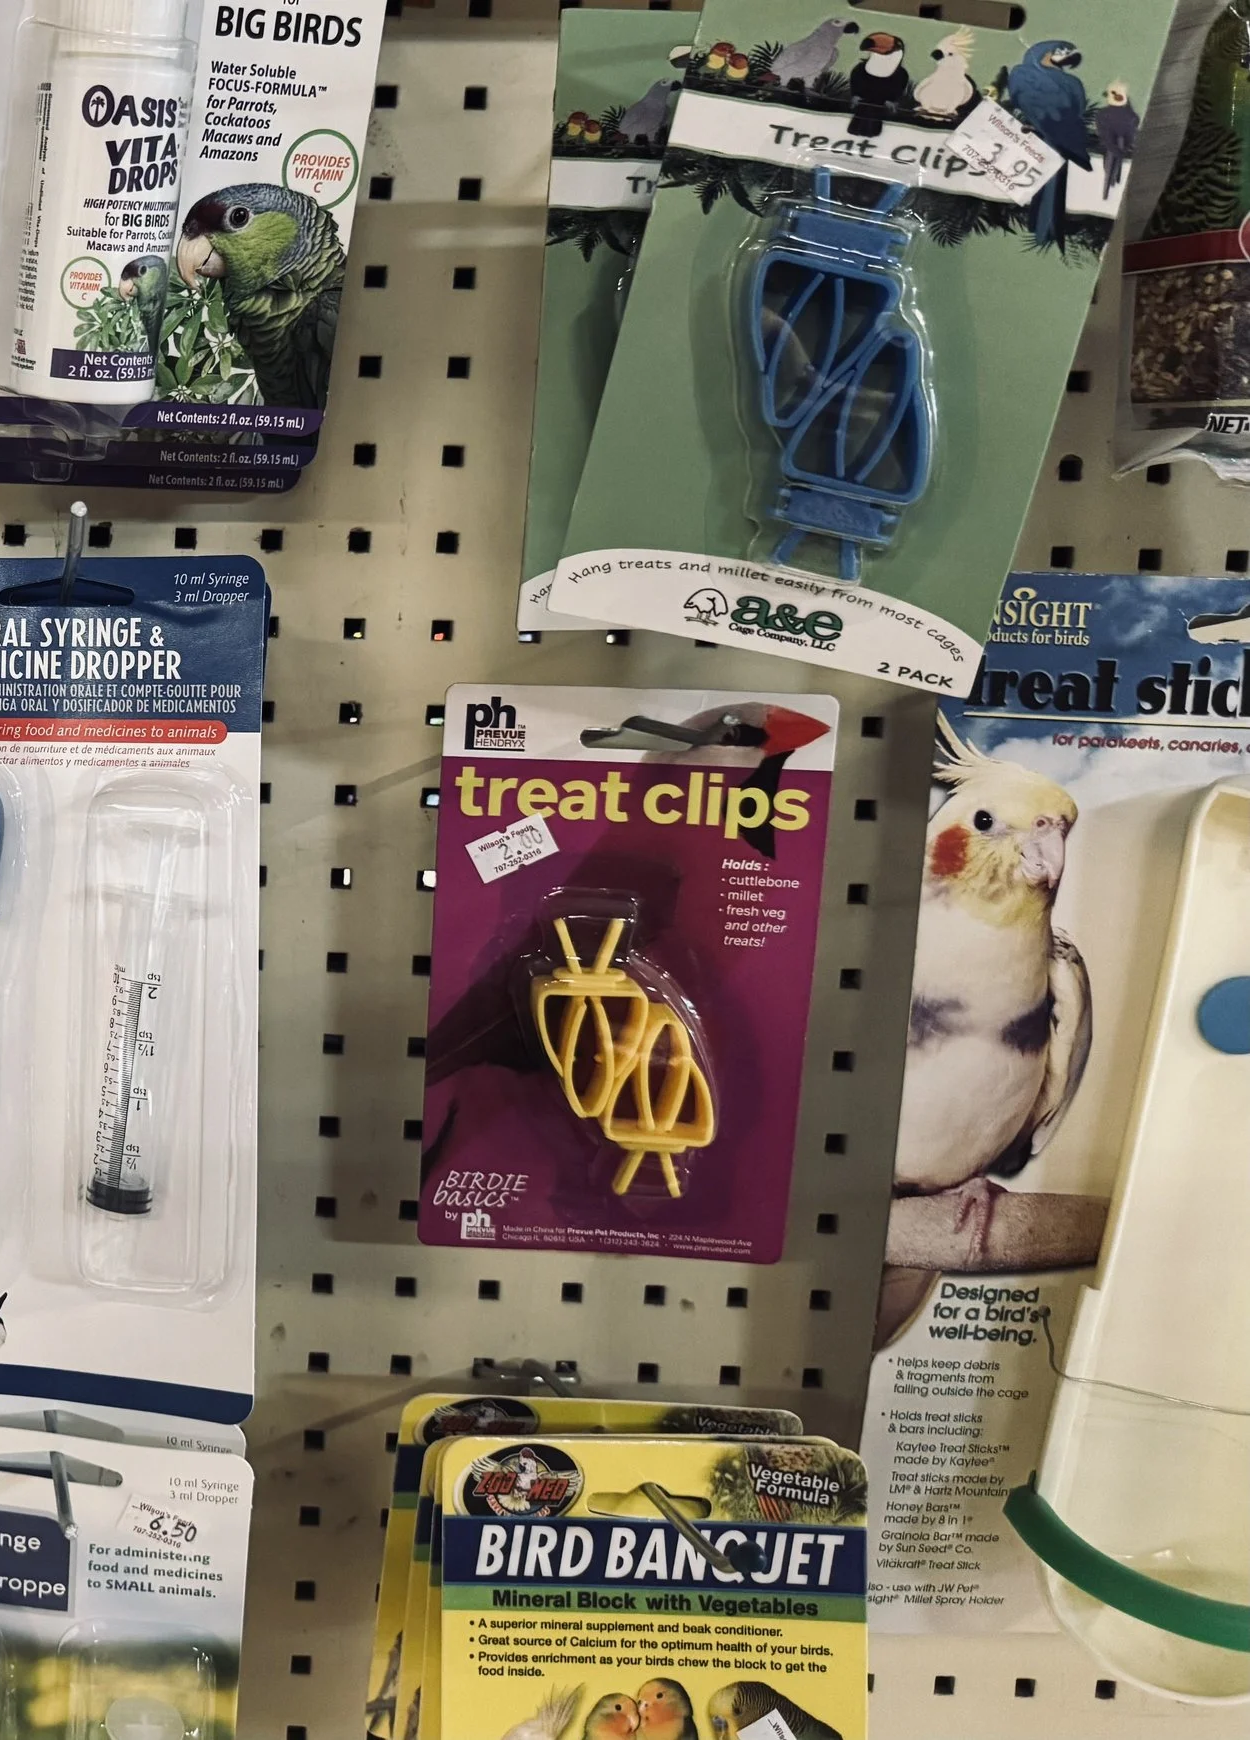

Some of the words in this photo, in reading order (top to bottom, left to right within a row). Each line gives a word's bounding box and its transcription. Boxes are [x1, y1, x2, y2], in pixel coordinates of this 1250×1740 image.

[216, 6, 265, 39] BIG
[273, 11, 362, 47] BIRDS
[205, 112, 270, 129] Cockatoos
[202, 129, 253, 144] Macaws
[256, 133, 282, 146] and
[770, 124, 877, 159] Treat
[199, 145, 258, 161] Amazons
[174, 574, 187, 585] 10
[190, 573, 205, 584] ml
[208, 573, 249, 587] Syringe
[174, 591, 181, 602] 3
[185, 590, 199, 602] ml
[203, 591, 249, 605] Dropper
[567, 559, 612, 583] Hang
[618, 557, 673, 572] treats
[679, 559, 711, 575] and
[717, 562, 769, 582] millet
[775, 575, 825, 596] easily
[831, 587, 873, 609] from
[878, 603, 922, 630] most
[926, 624, 965, 664] cages
[40, 618, 141, 647] SYRINGE
[150, 626, 164, 646] &
[728, 621, 758, 637] Cage
[71, 650, 181, 679] DROPPER
[878, 662, 890, 673] 2
[898, 667, 952, 688] PACK
[26, 723, 54, 736] food
[57, 724, 81, 736] and
[84, 725, 146, 737] medicines
[151, 726, 163, 737] to
[168, 726, 217, 738] animals
[476, 730, 525, 739] PREVUE
[476, 739, 524, 747] HENDRYX
[455, 767, 630, 822] treat
[643, 772, 812, 839] clips
[729, 876, 799, 888] cuttlebone
[728, 891, 763, 901] millet
[727, 905, 759, 916] fresh
[762, 909, 786, 920] veg
[941, 1282, 1041, 1304] Designed
[934, 1303, 962, 1319] for
[965, 1308, 980, 1320] a
[929, 1324, 1038, 1346] well-being.
[752, 1464, 839, 1496] Vegetable
[756, 1476, 829, 1507] Formula
[476, 1525, 593, 1577] BIRD
[88, 1560, 118, 1572] food
[124, 1565, 148, 1575] and
[154, 1568, 222, 1581] medicines
[88, 1579, 101, 1588] to
[106, 1579, 154, 1592] SMALL
[159, 1584, 216, 1598] animals.
[493, 1590, 571, 1609] Mineral
[577, 1592, 637, 1610] Block
[647, 1595, 693, 1611] with
[698, 1597, 818, 1617] Vegetables
[479, 1635, 509, 1645] Great
[513, 1635, 552, 1648] source
[555, 1636, 567, 1647] of
[570, 1636, 617, 1648] Calcium
[621, 1638, 636, 1648] for
[640, 1639, 658, 1649] the
[661, 1640, 712, 1652] optimum
[717, 1641, 752, 1652] health
[756, 1643, 767, 1653] of
[771, 1646, 797, 1656] your
[801, 1645, 833, 1656] birds.
